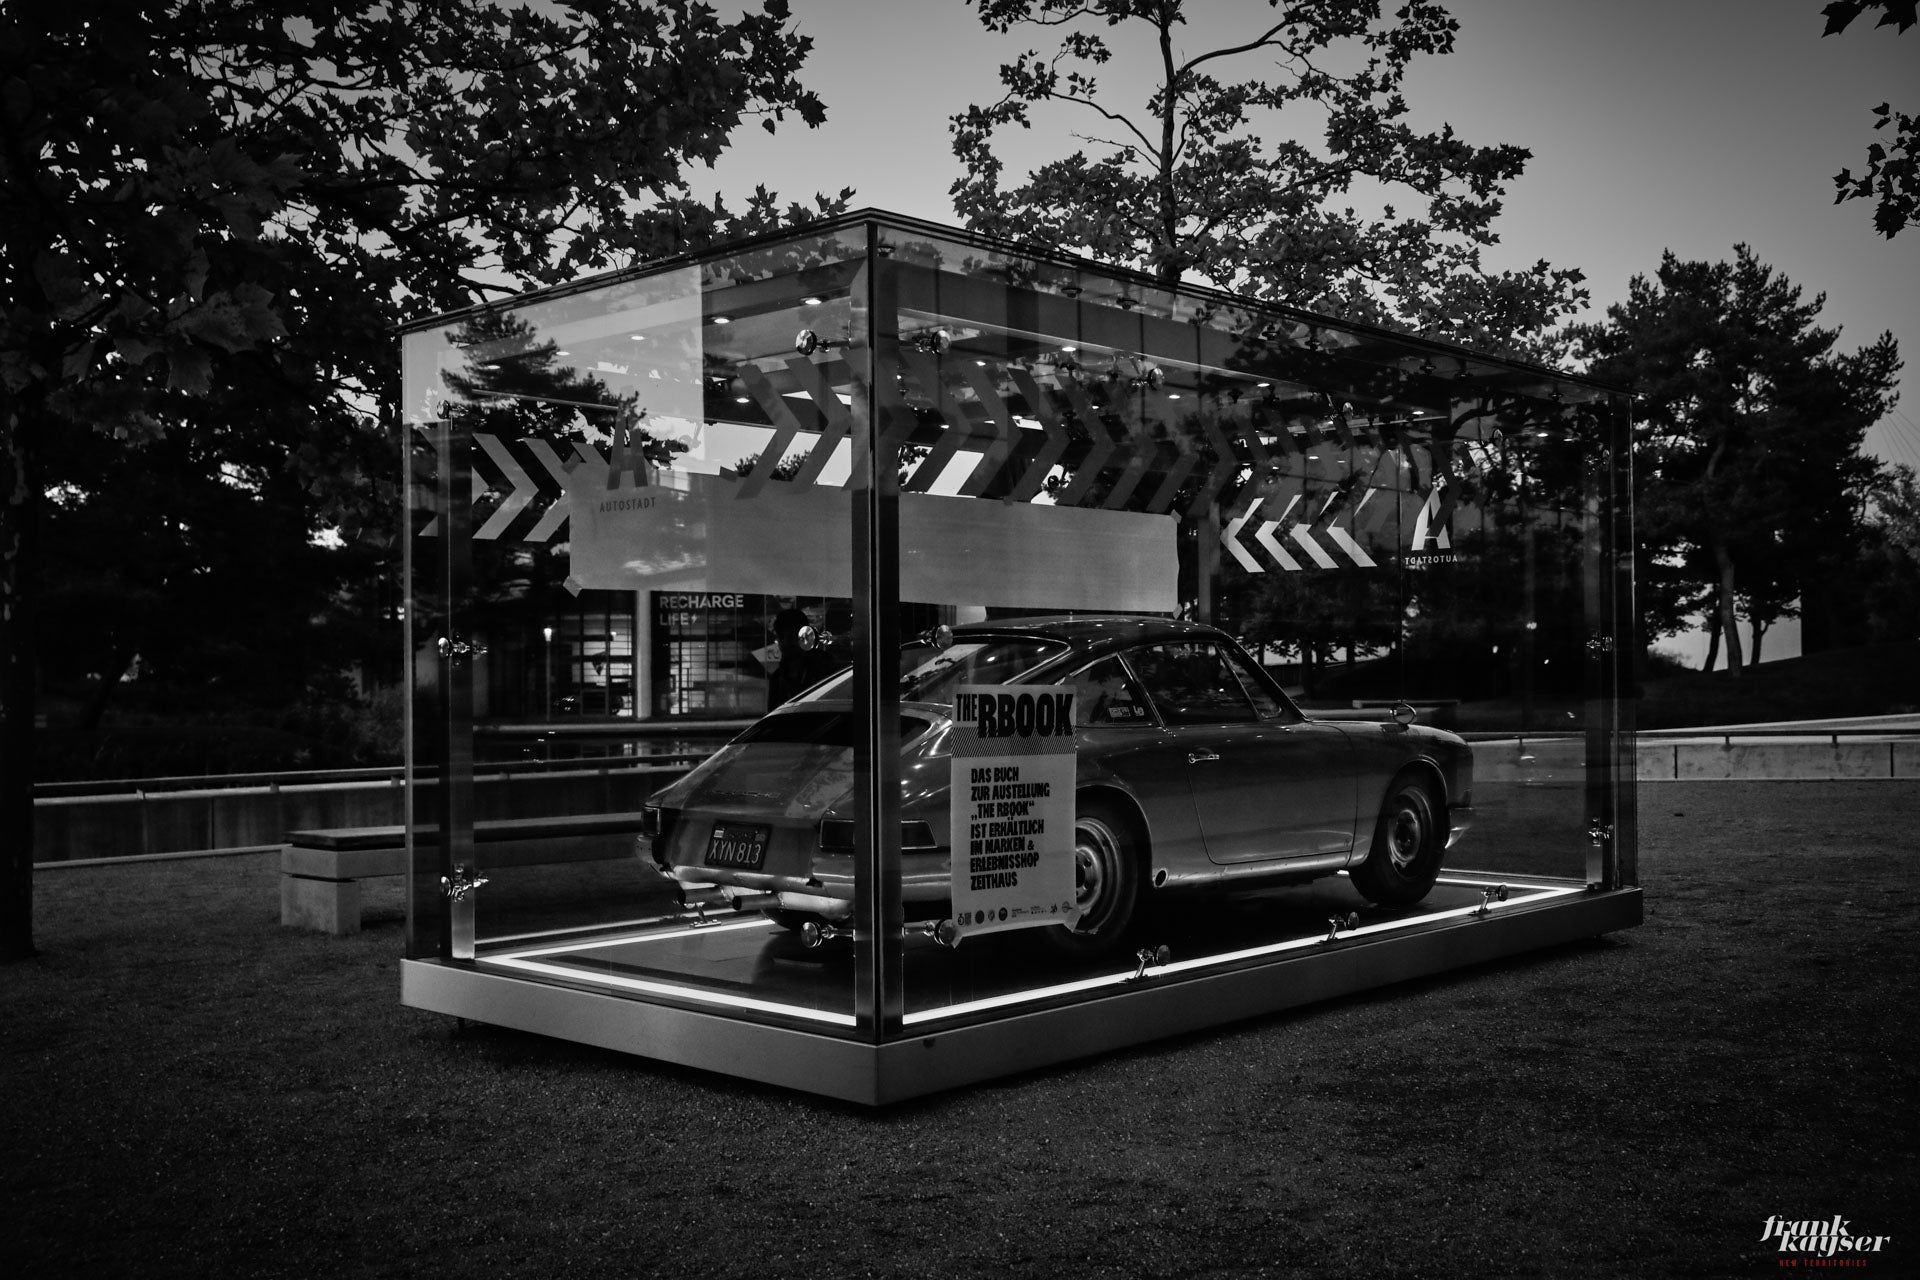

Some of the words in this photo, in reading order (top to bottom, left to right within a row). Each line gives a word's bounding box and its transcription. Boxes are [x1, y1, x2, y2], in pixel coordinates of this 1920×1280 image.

[599, 496, 657, 513] AUTOSTADT
[659, 594, 744, 609] RECHARGE
[659, 612, 690, 626] LIFE
[956, 694, 978, 722] THE
[978, 693, 1074, 738] RBOOK
[971, 768, 991, 783] DAS
[994, 767, 1019, 782] BUCH
[971, 786, 990, 801] ZUR
[992, 783, 1050, 800] AUSTELLUNG
[971, 823, 987, 838] IST
[989, 817, 1044, 837] ERHÄLTLICH
[708, 840, 737, 861] XYN
[737, 842, 762, 863] 813
[971, 840, 983, 855] IM
[985, 837, 1025, 854] MARKEN
[1027, 840, 1034, 851] &
[970, 853, 1039, 873] ERLEBNISSHOP
[971, 872, 1018, 890] ZEITHAUS
